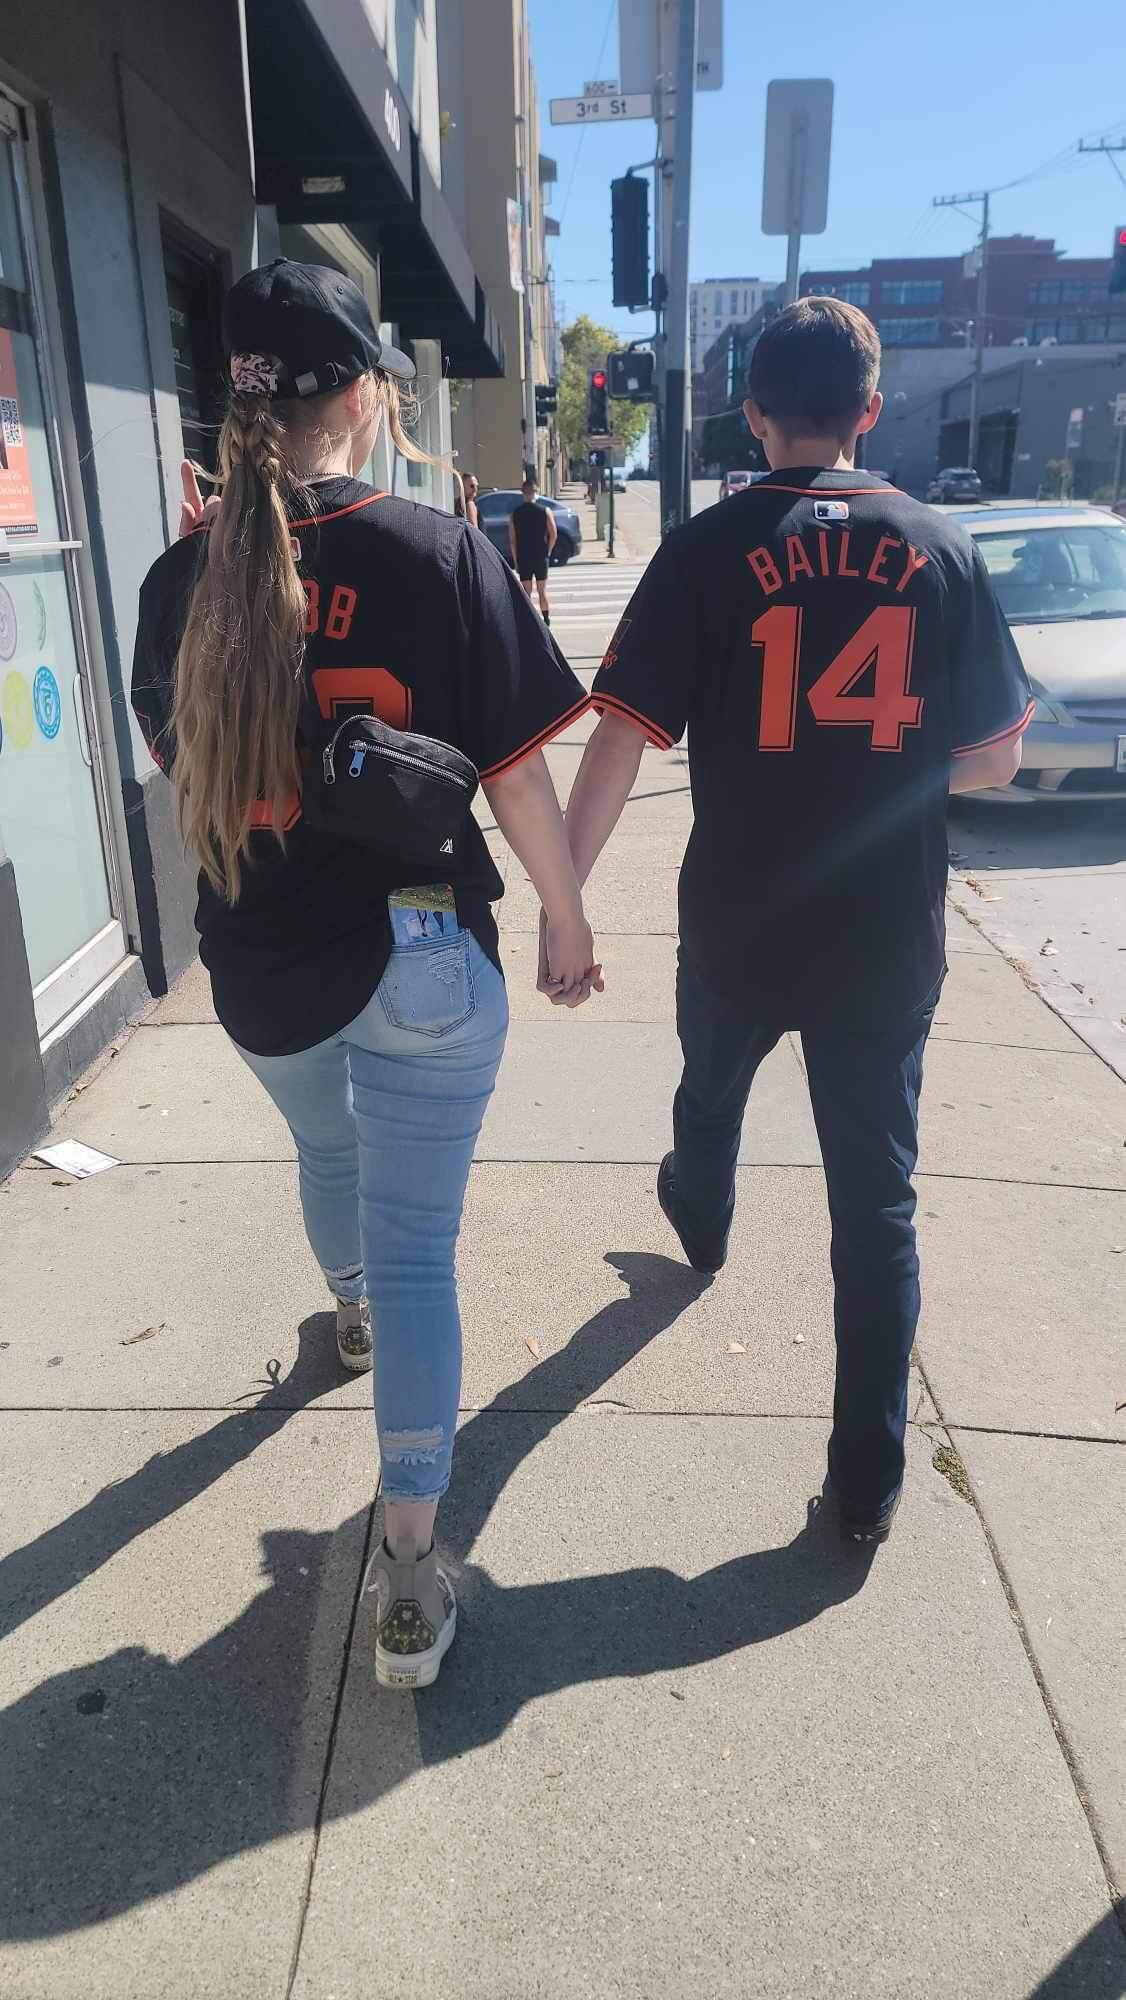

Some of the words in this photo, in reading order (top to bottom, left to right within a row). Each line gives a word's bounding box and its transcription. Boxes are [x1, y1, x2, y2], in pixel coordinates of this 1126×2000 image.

[576, 102, 599, 117] 3rd
[610, 100, 626, 114] St
[746, 529, 929, 596] BAILEY
[750, 605, 925, 753] 14
